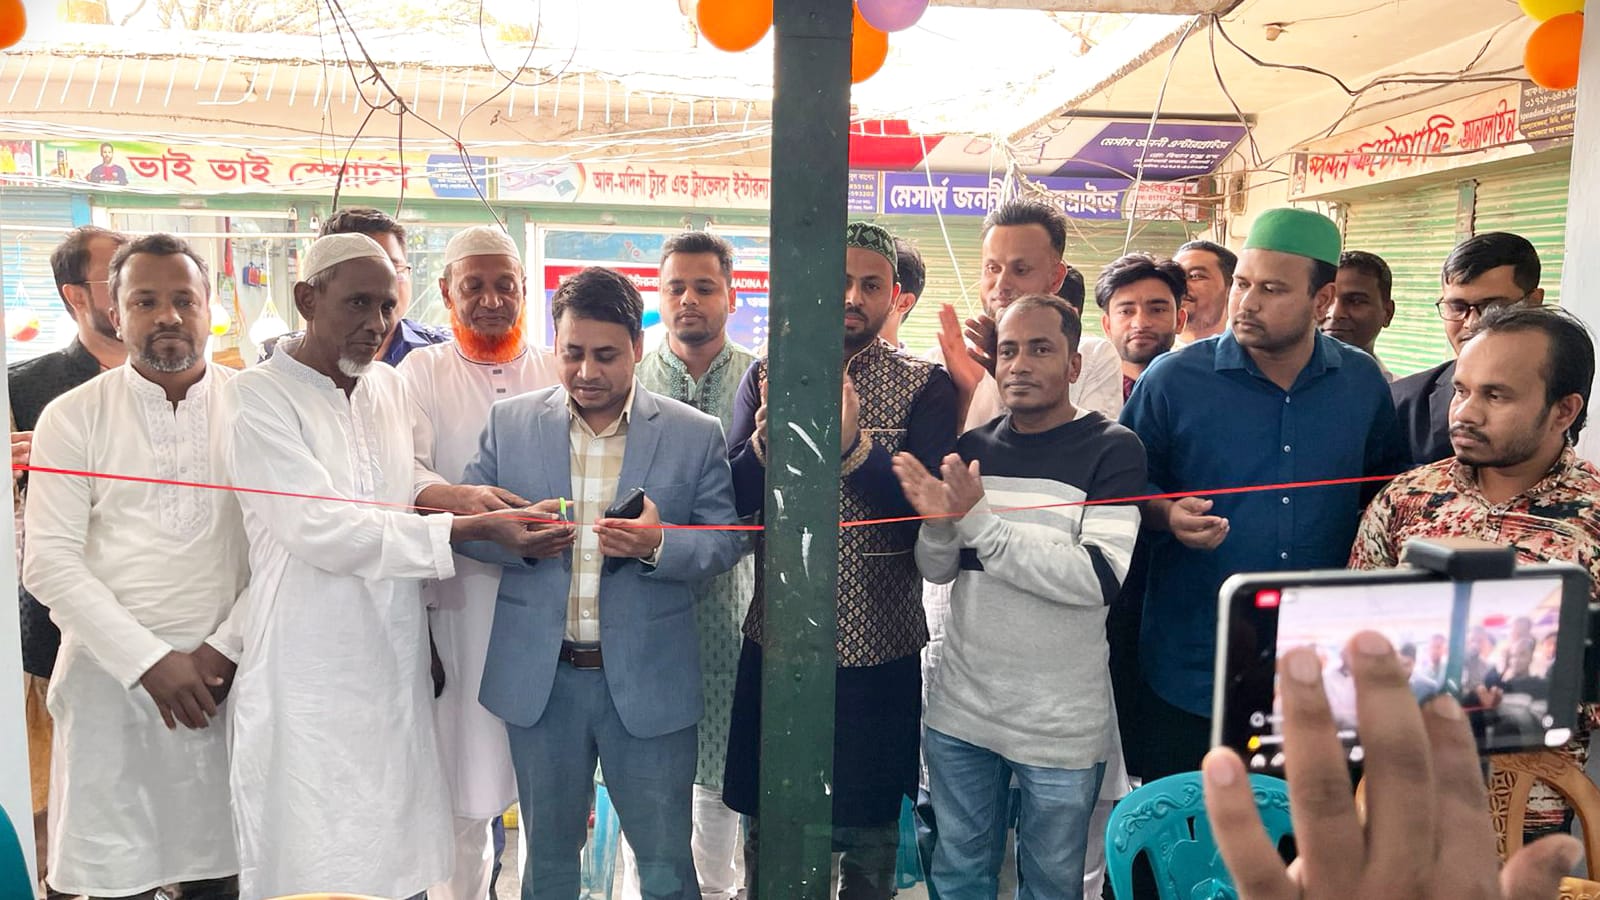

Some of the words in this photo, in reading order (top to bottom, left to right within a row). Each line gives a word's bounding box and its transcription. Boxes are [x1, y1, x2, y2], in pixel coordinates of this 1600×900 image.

[127, 147, 196, 185] ভাই
[208, 151, 274, 186] ভাই
[592, 166, 646, 195] আল-মদিনা
[889, 177, 949, 209] মেসার্স
